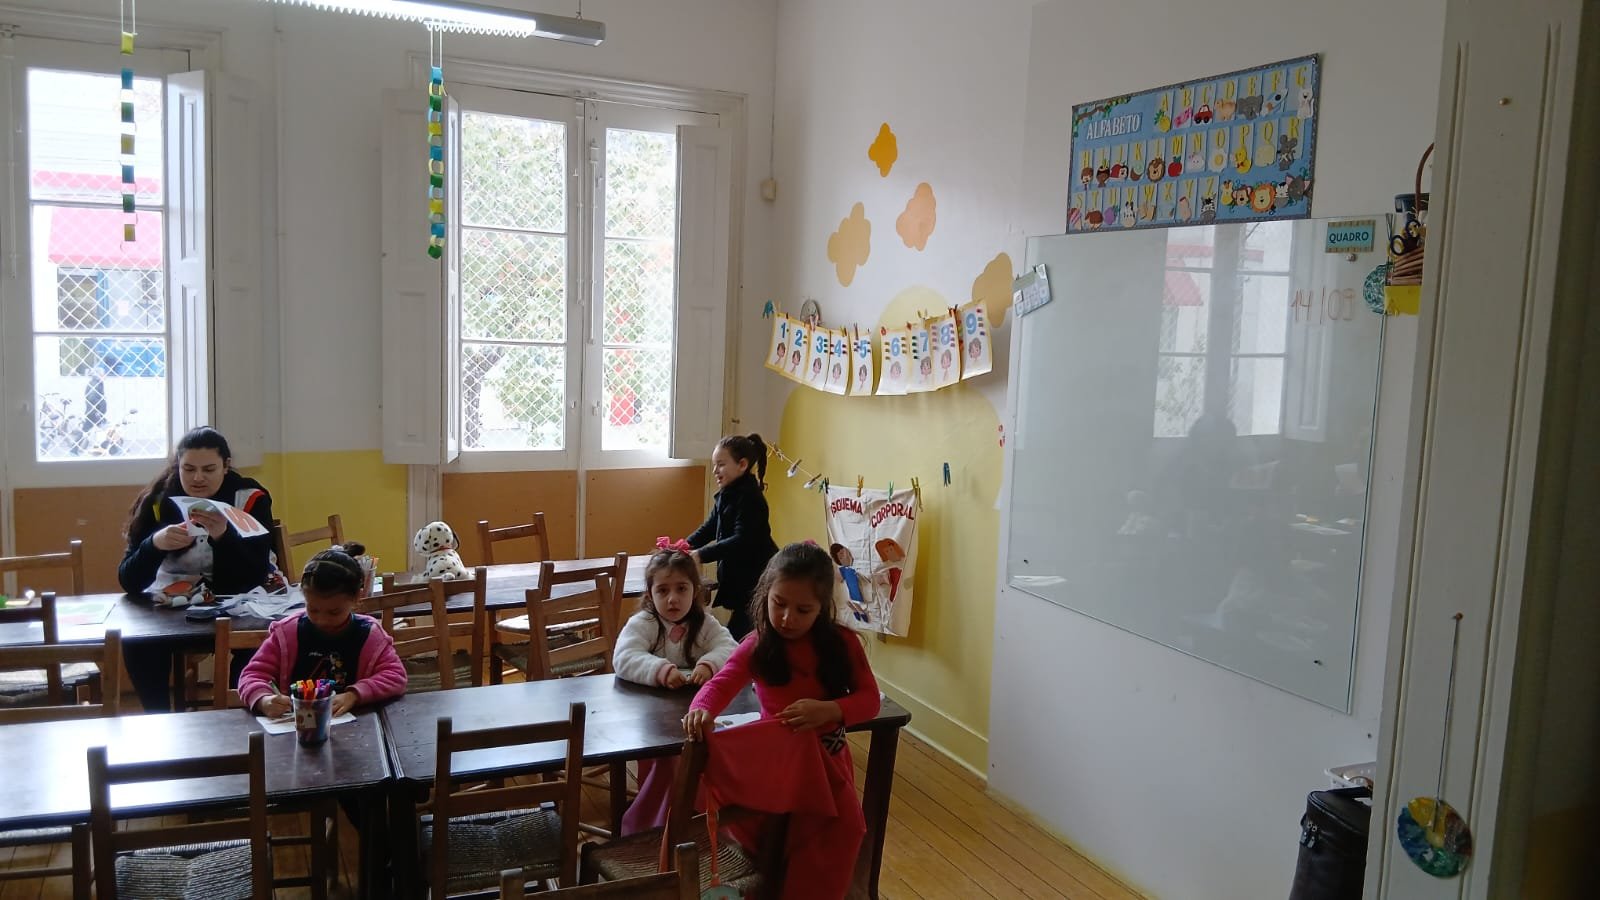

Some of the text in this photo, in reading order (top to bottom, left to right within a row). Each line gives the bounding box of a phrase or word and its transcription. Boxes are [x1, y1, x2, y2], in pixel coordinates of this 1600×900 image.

[1162, 66, 1307, 112] A B C D E F G
[1086, 113, 1141, 140] ALFABETO
[1172, 135, 1183, 155] M
[1193, 133, 1202, 152] N
[1216, 128, 1226, 149] O
[1240, 125, 1250, 145] P
[1263, 121, 1274, 144] Q
[1288, 116, 1299, 138] R
[1143, 185, 1155, 204] W
[1164, 182, 1173, 202] X
[1185, 179, 1194, 198] Y
[1205, 176, 1214, 196] Z
[1328, 231, 1370, 244] QUADRO
[780, 312, 977, 359] 1 2 3 4 5 6 7 8 9
[871, 502, 915, 529] CORPORAL
